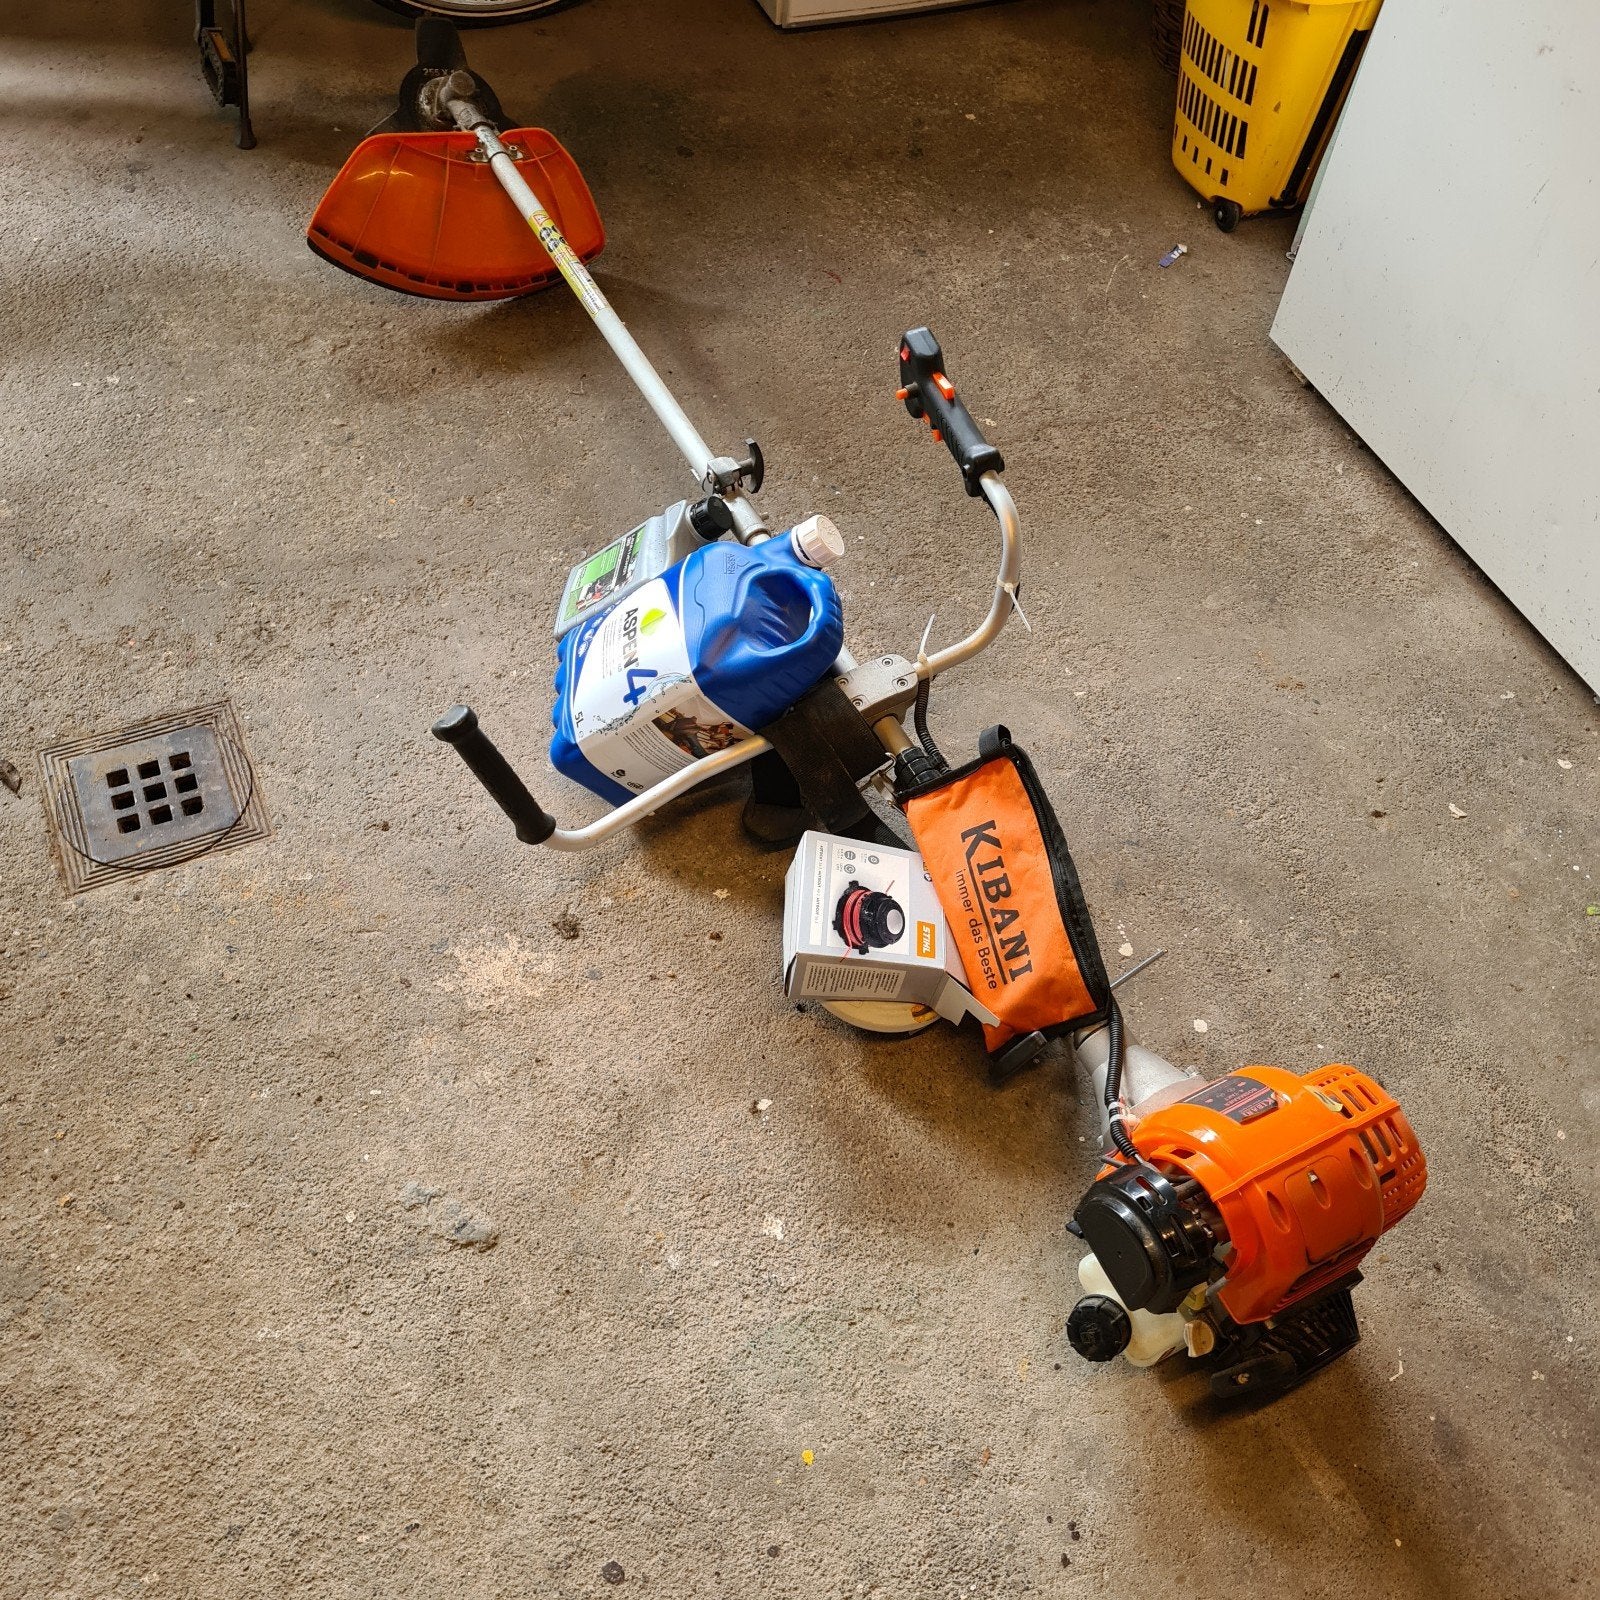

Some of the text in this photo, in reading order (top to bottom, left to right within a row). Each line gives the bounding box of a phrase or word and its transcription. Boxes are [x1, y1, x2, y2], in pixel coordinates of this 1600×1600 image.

[623, 607, 658, 705] ASPEN 4
[574, 711, 584, 728] 5L
[922, 925, 931, 954] STIHL
[956, 869, 997, 990] immer das Beste
[961, 820, 1033, 982] KIBANI
